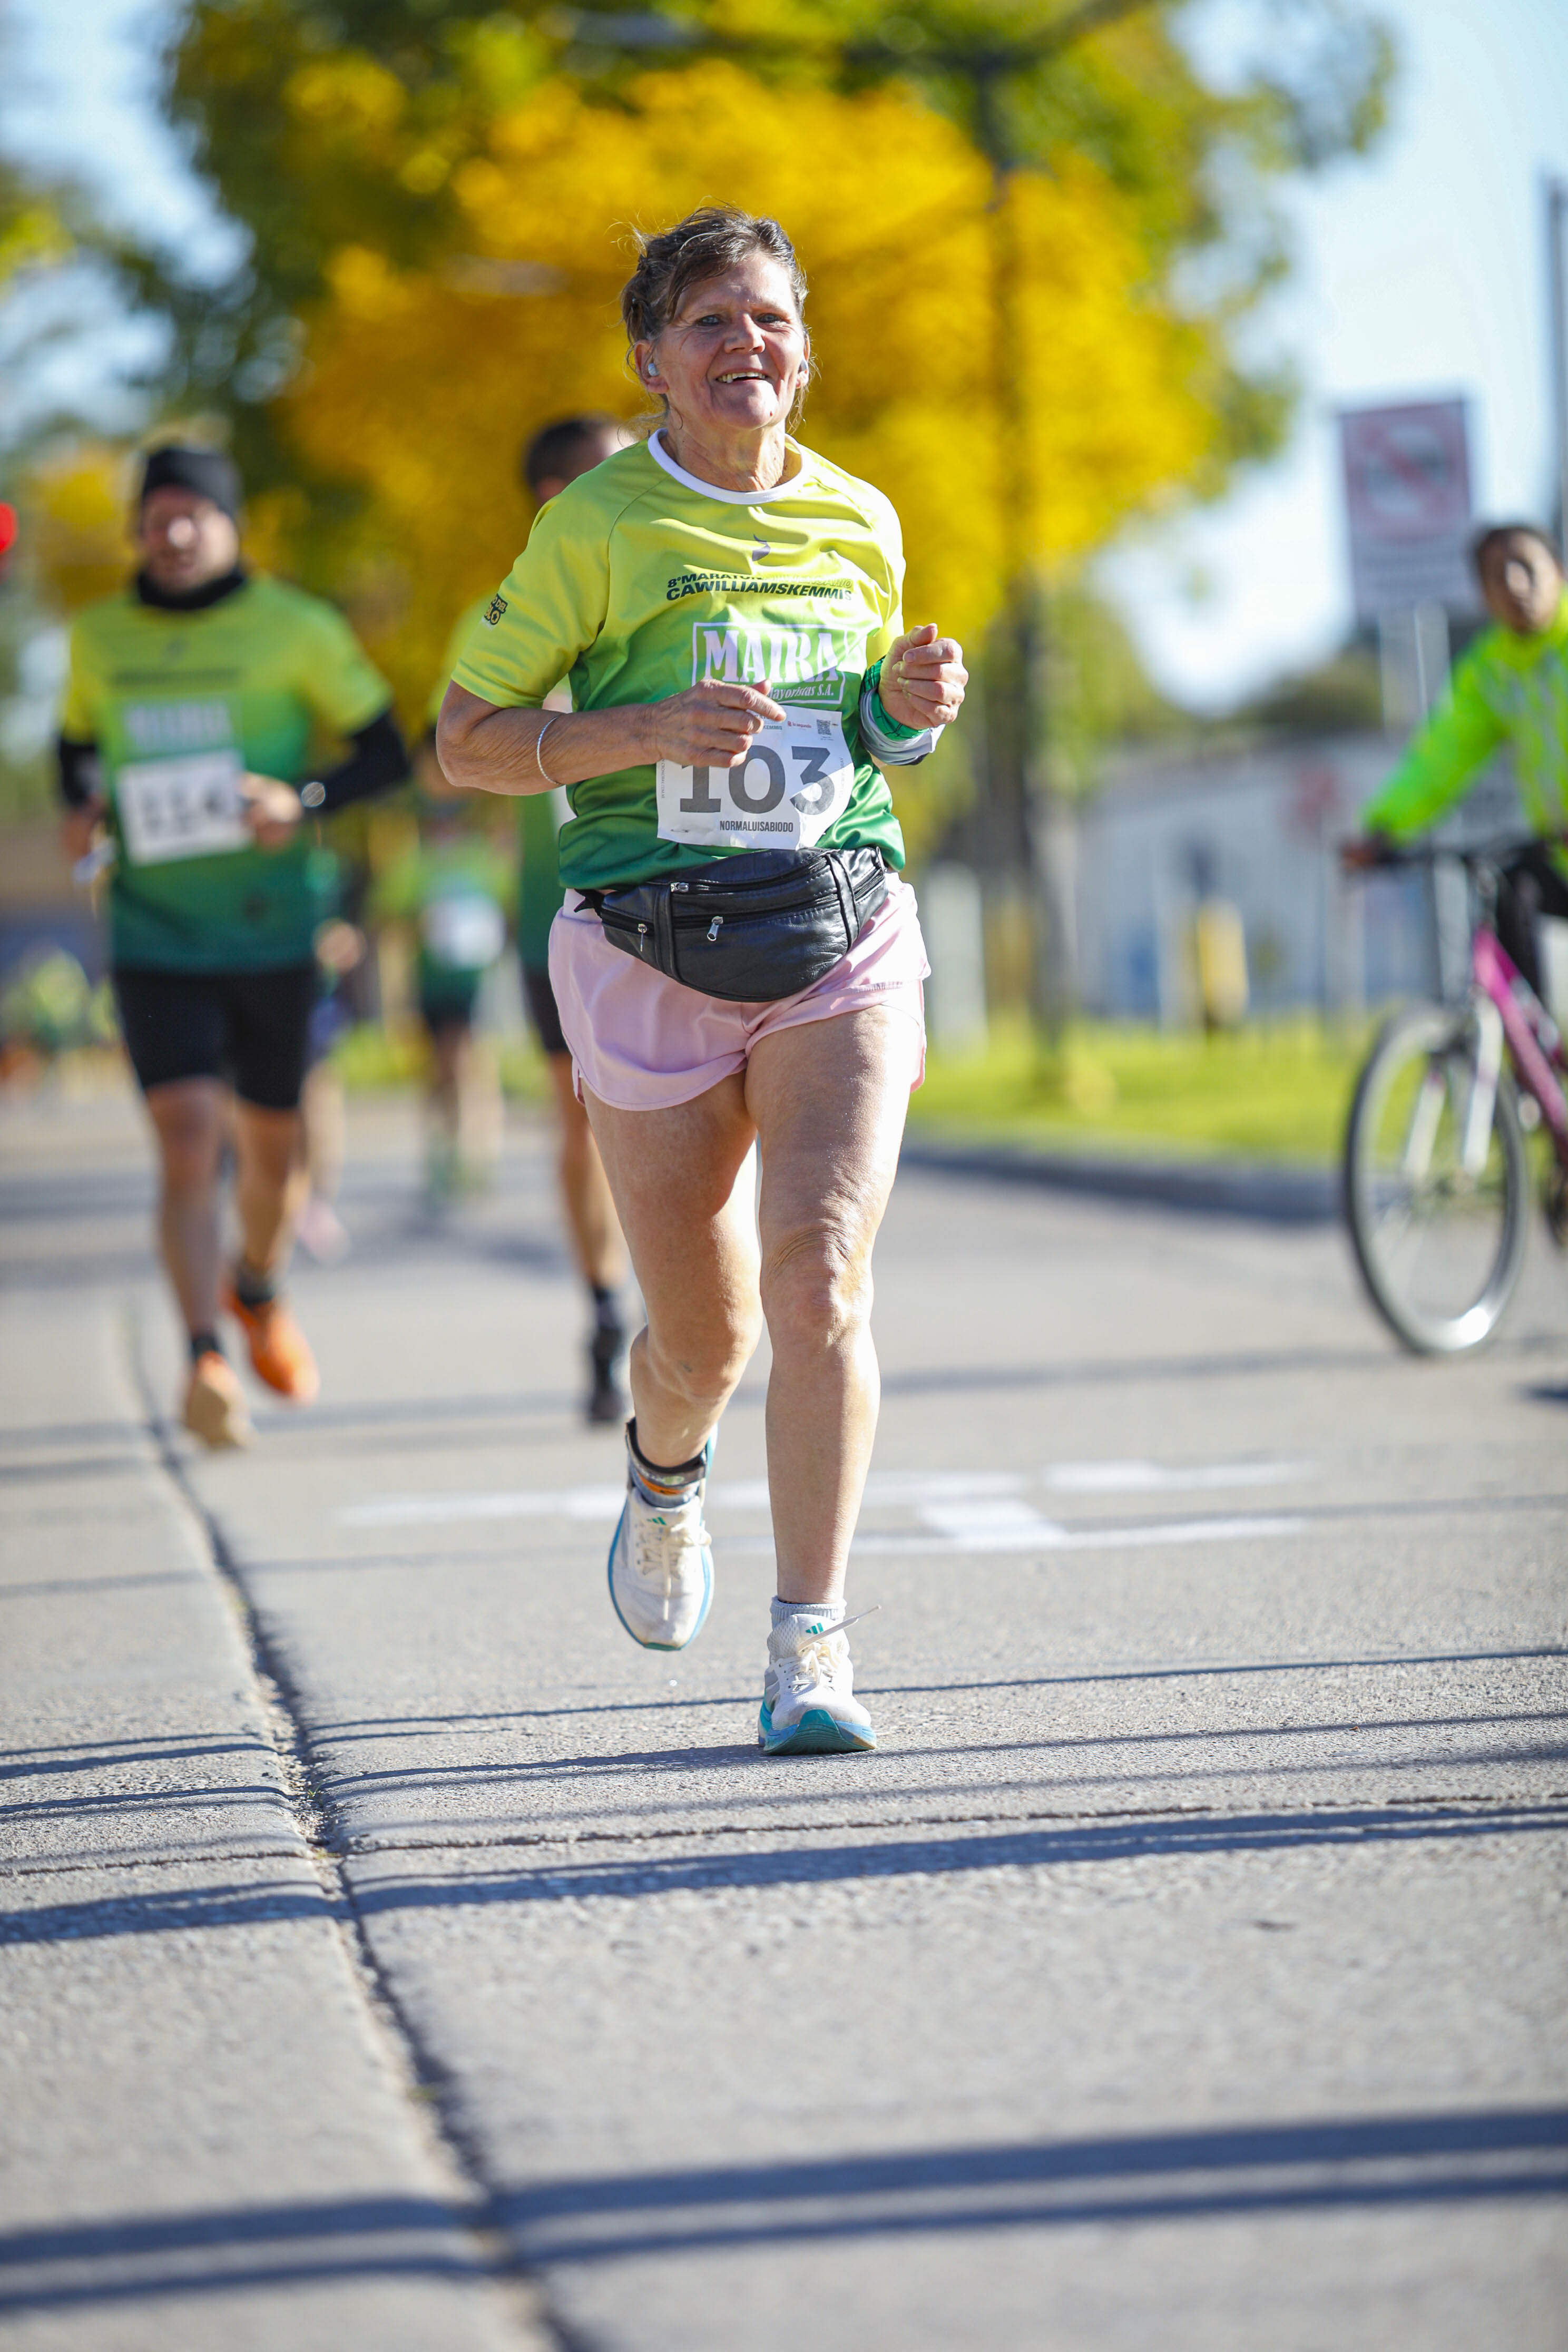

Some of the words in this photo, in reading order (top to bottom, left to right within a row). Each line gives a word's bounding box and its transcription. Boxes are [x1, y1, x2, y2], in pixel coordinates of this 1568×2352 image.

[703, 630, 838, 682] MAIRA
[817, 683, 834, 695] S.A.
[680, 745, 835, 815] 103
